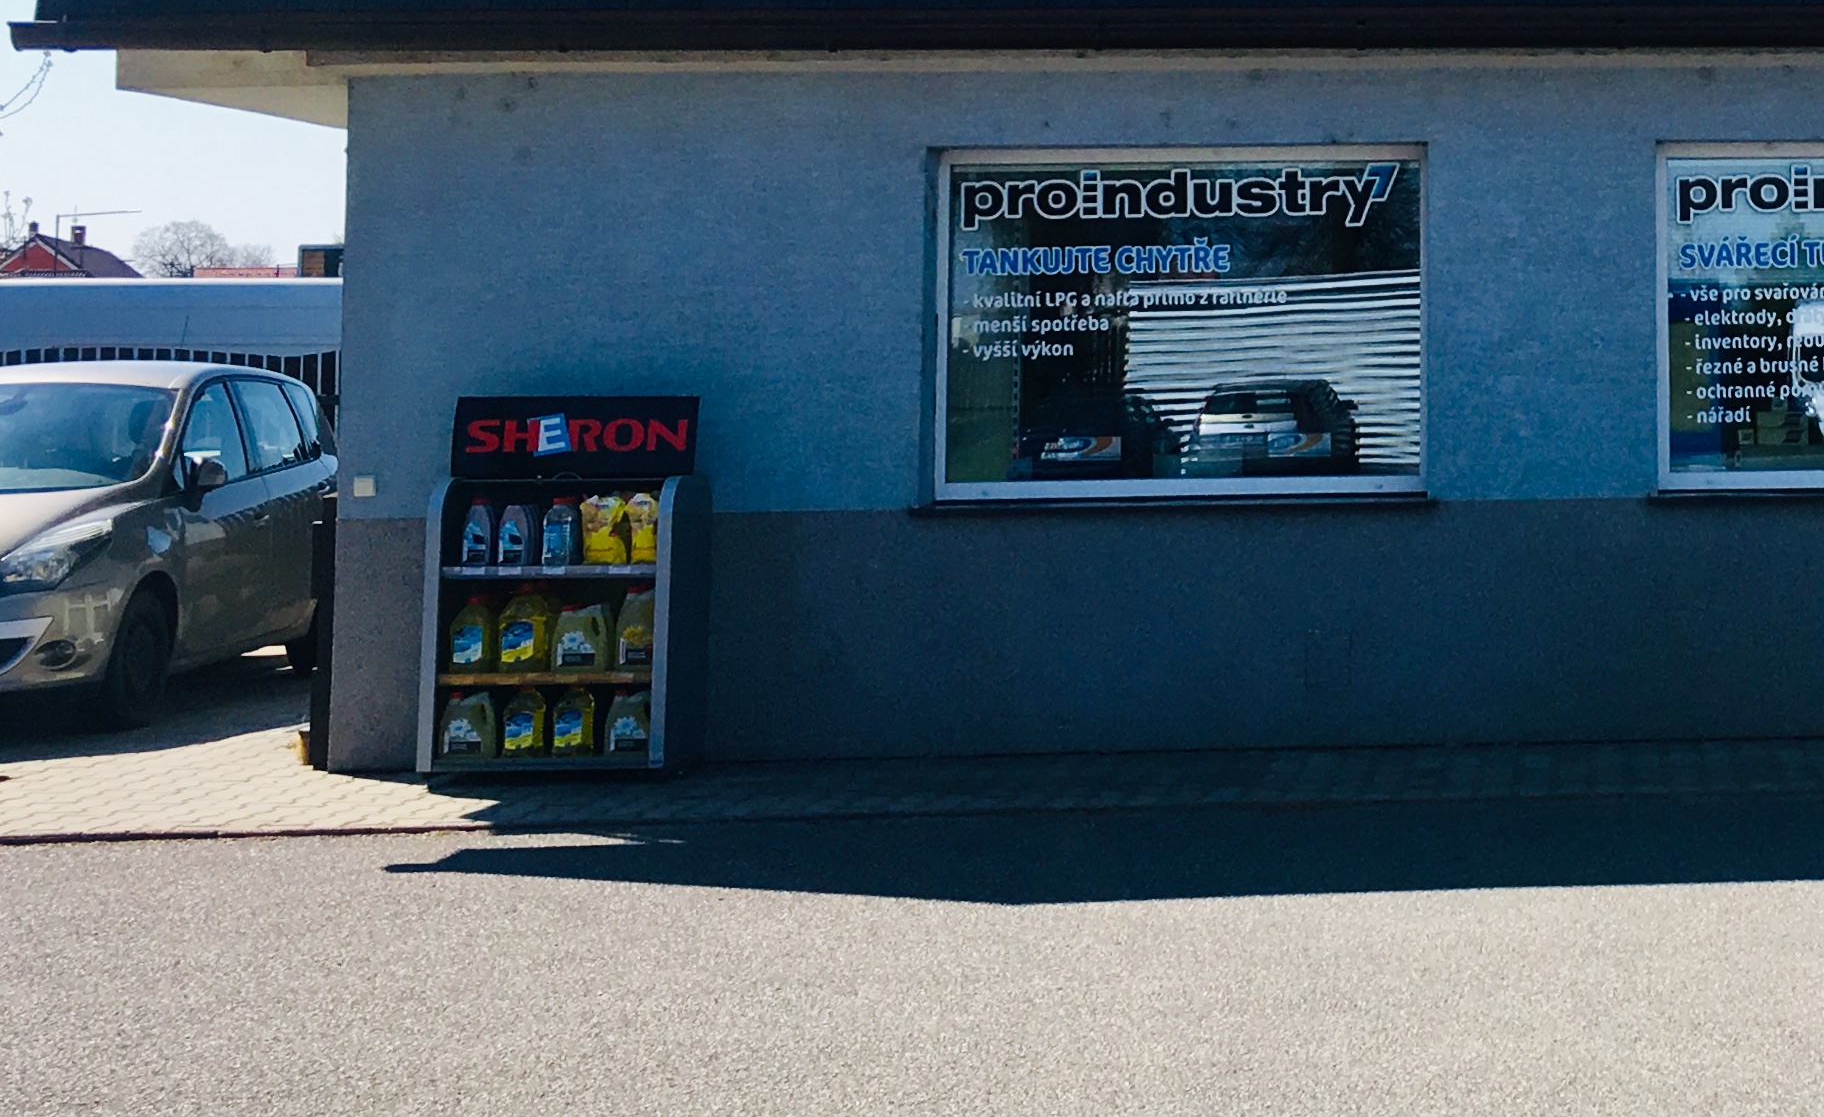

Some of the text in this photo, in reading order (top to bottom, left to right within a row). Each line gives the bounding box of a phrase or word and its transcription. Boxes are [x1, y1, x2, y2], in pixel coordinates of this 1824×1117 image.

[961, 169, 1377, 230] proindustry
[962, 236, 1231, 276] TANKUJTE CHYTŘE
[1679, 234, 1799, 270] SVÁŘECÍ
[973, 291, 1042, 308] kvalitní
[1046, 291, 1078, 308] LPG
[1081, 295, 1090, 307] a
[1094, 289, 1140, 307] nafta
[1690, 285, 1719, 302] vše
[1722, 287, 1751, 304] pro
[975, 314, 1110, 336] menší spotřeba
[1694, 309, 1783, 327] elektrody,
[973, 341, 1075, 362] vyšší výkon
[1694, 334, 1783, 352] inventory,
[1695, 355, 1743, 375] řezné
[1747, 360, 1756, 373] a
[1759, 356, 1819, 374] brusné
[1696, 381, 1776, 399] ochranné
[1696, 405, 1751, 424] nářadí
[465, 415, 689, 455] SHERON
